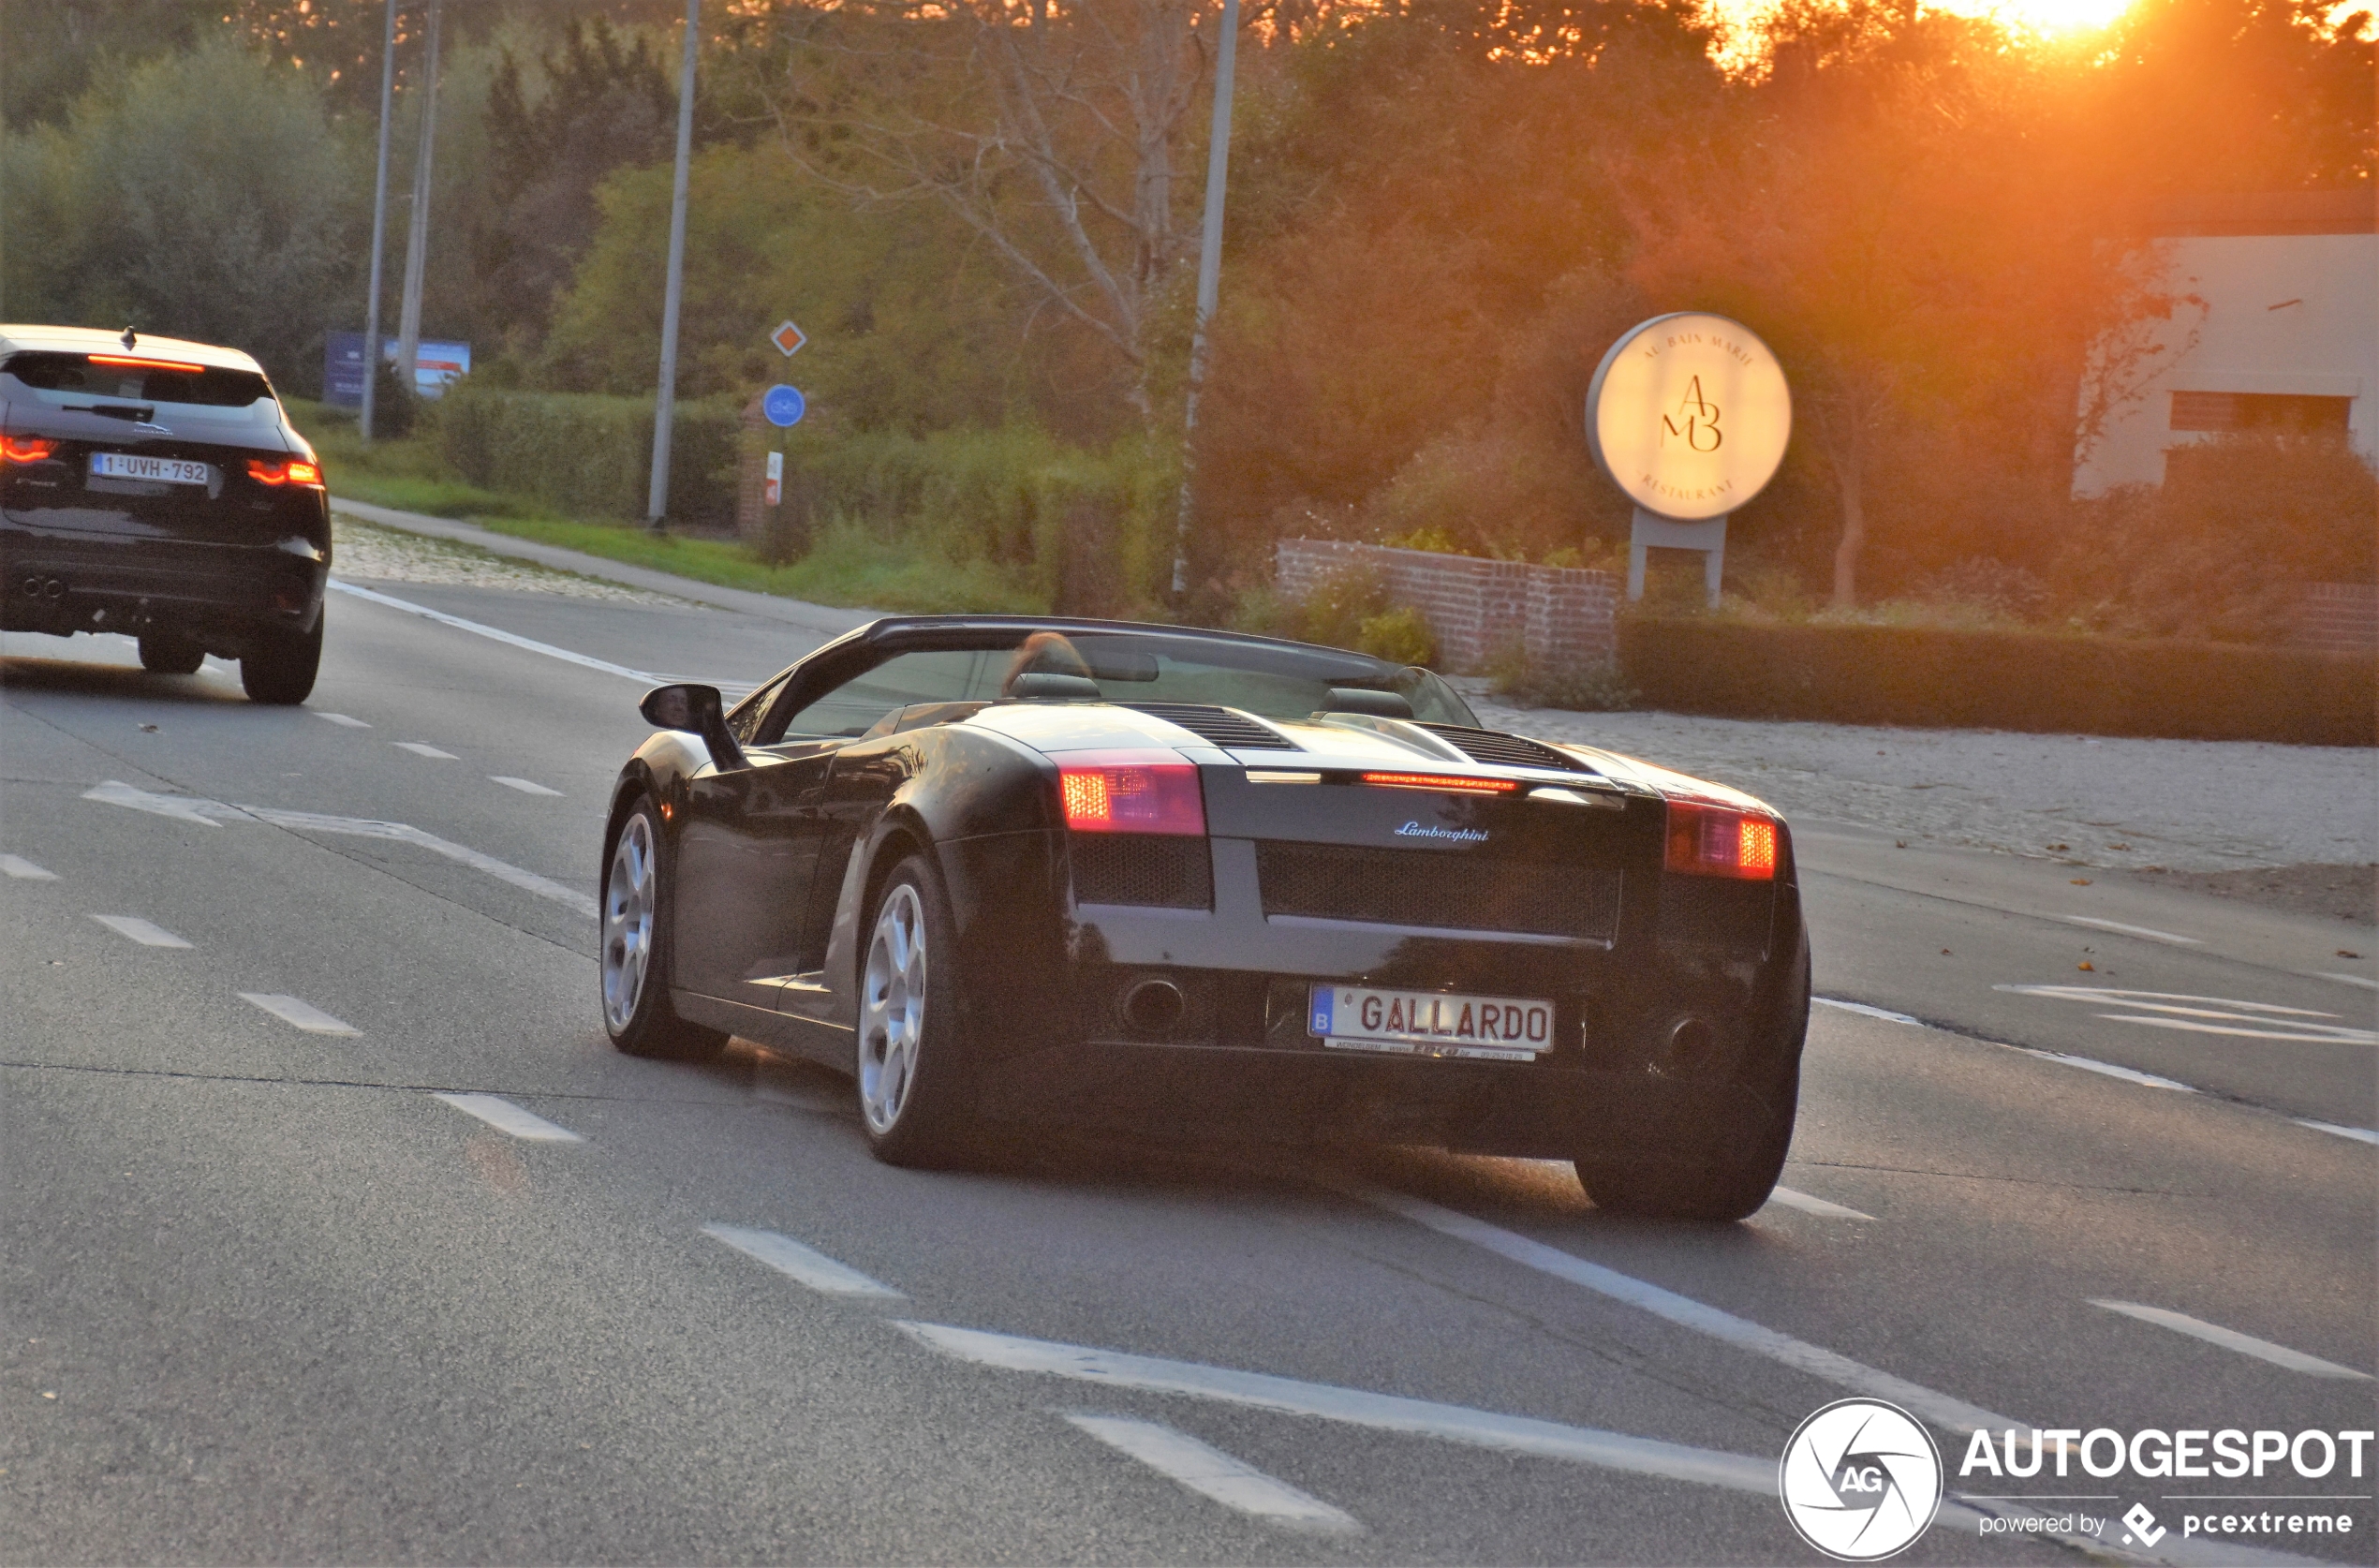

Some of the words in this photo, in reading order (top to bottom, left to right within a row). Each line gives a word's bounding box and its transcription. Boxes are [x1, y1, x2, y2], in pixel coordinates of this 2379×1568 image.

[1667, 333, 1703, 348] BAIN
[1710, 335, 1753, 366] MARIE
[106, 456, 205, 481] 1-UVH-792
[1642, 473, 1734, 501] RESTAURANT
[1394, 821, 1489, 842] Lamborghini
[1314, 1013, 1329, 1030] B
[1360, 995, 1547, 1043] GALLARDO
